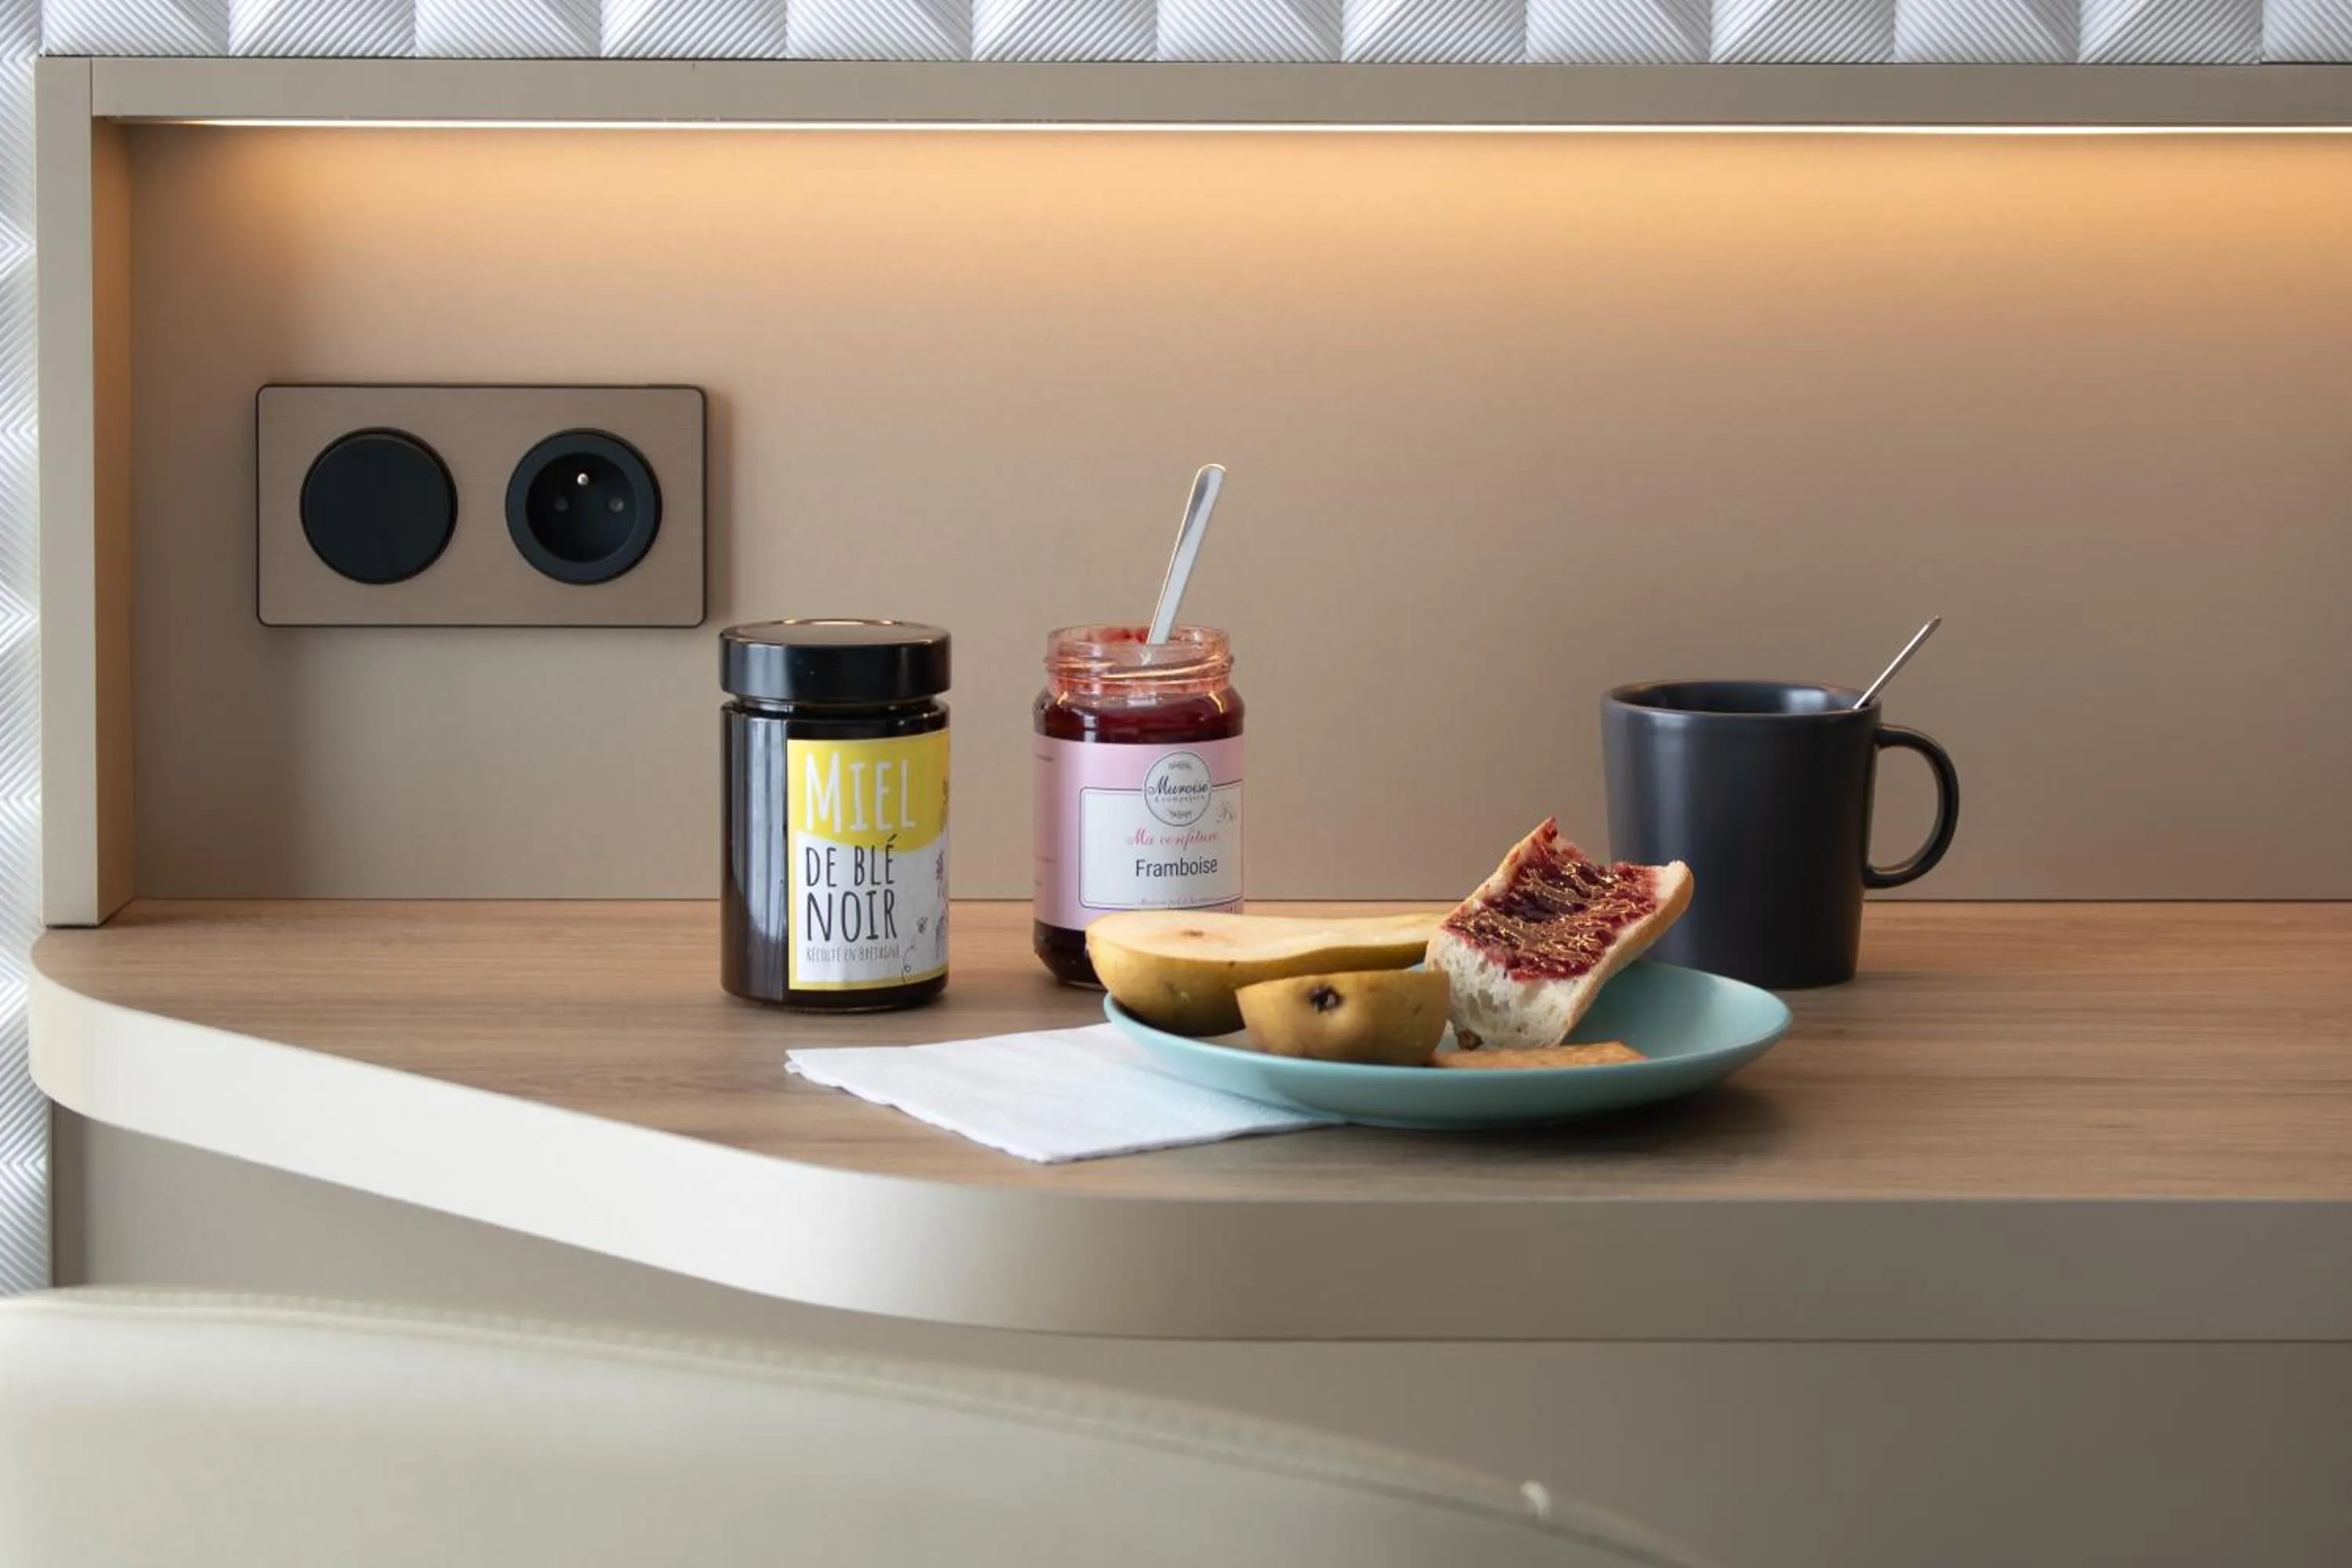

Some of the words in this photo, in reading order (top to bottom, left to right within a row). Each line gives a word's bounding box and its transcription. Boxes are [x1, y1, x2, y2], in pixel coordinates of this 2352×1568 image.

[805, 750, 916, 834] MIEL
[805, 846, 837, 888] DE
[854, 833, 897, 887] BLÉ
[1127, 827, 1153, 846] Ma
[1160, 827, 1219, 851] confiture
[1135, 855, 1219, 877] Framboise
[806, 888, 898, 943] NOIR
